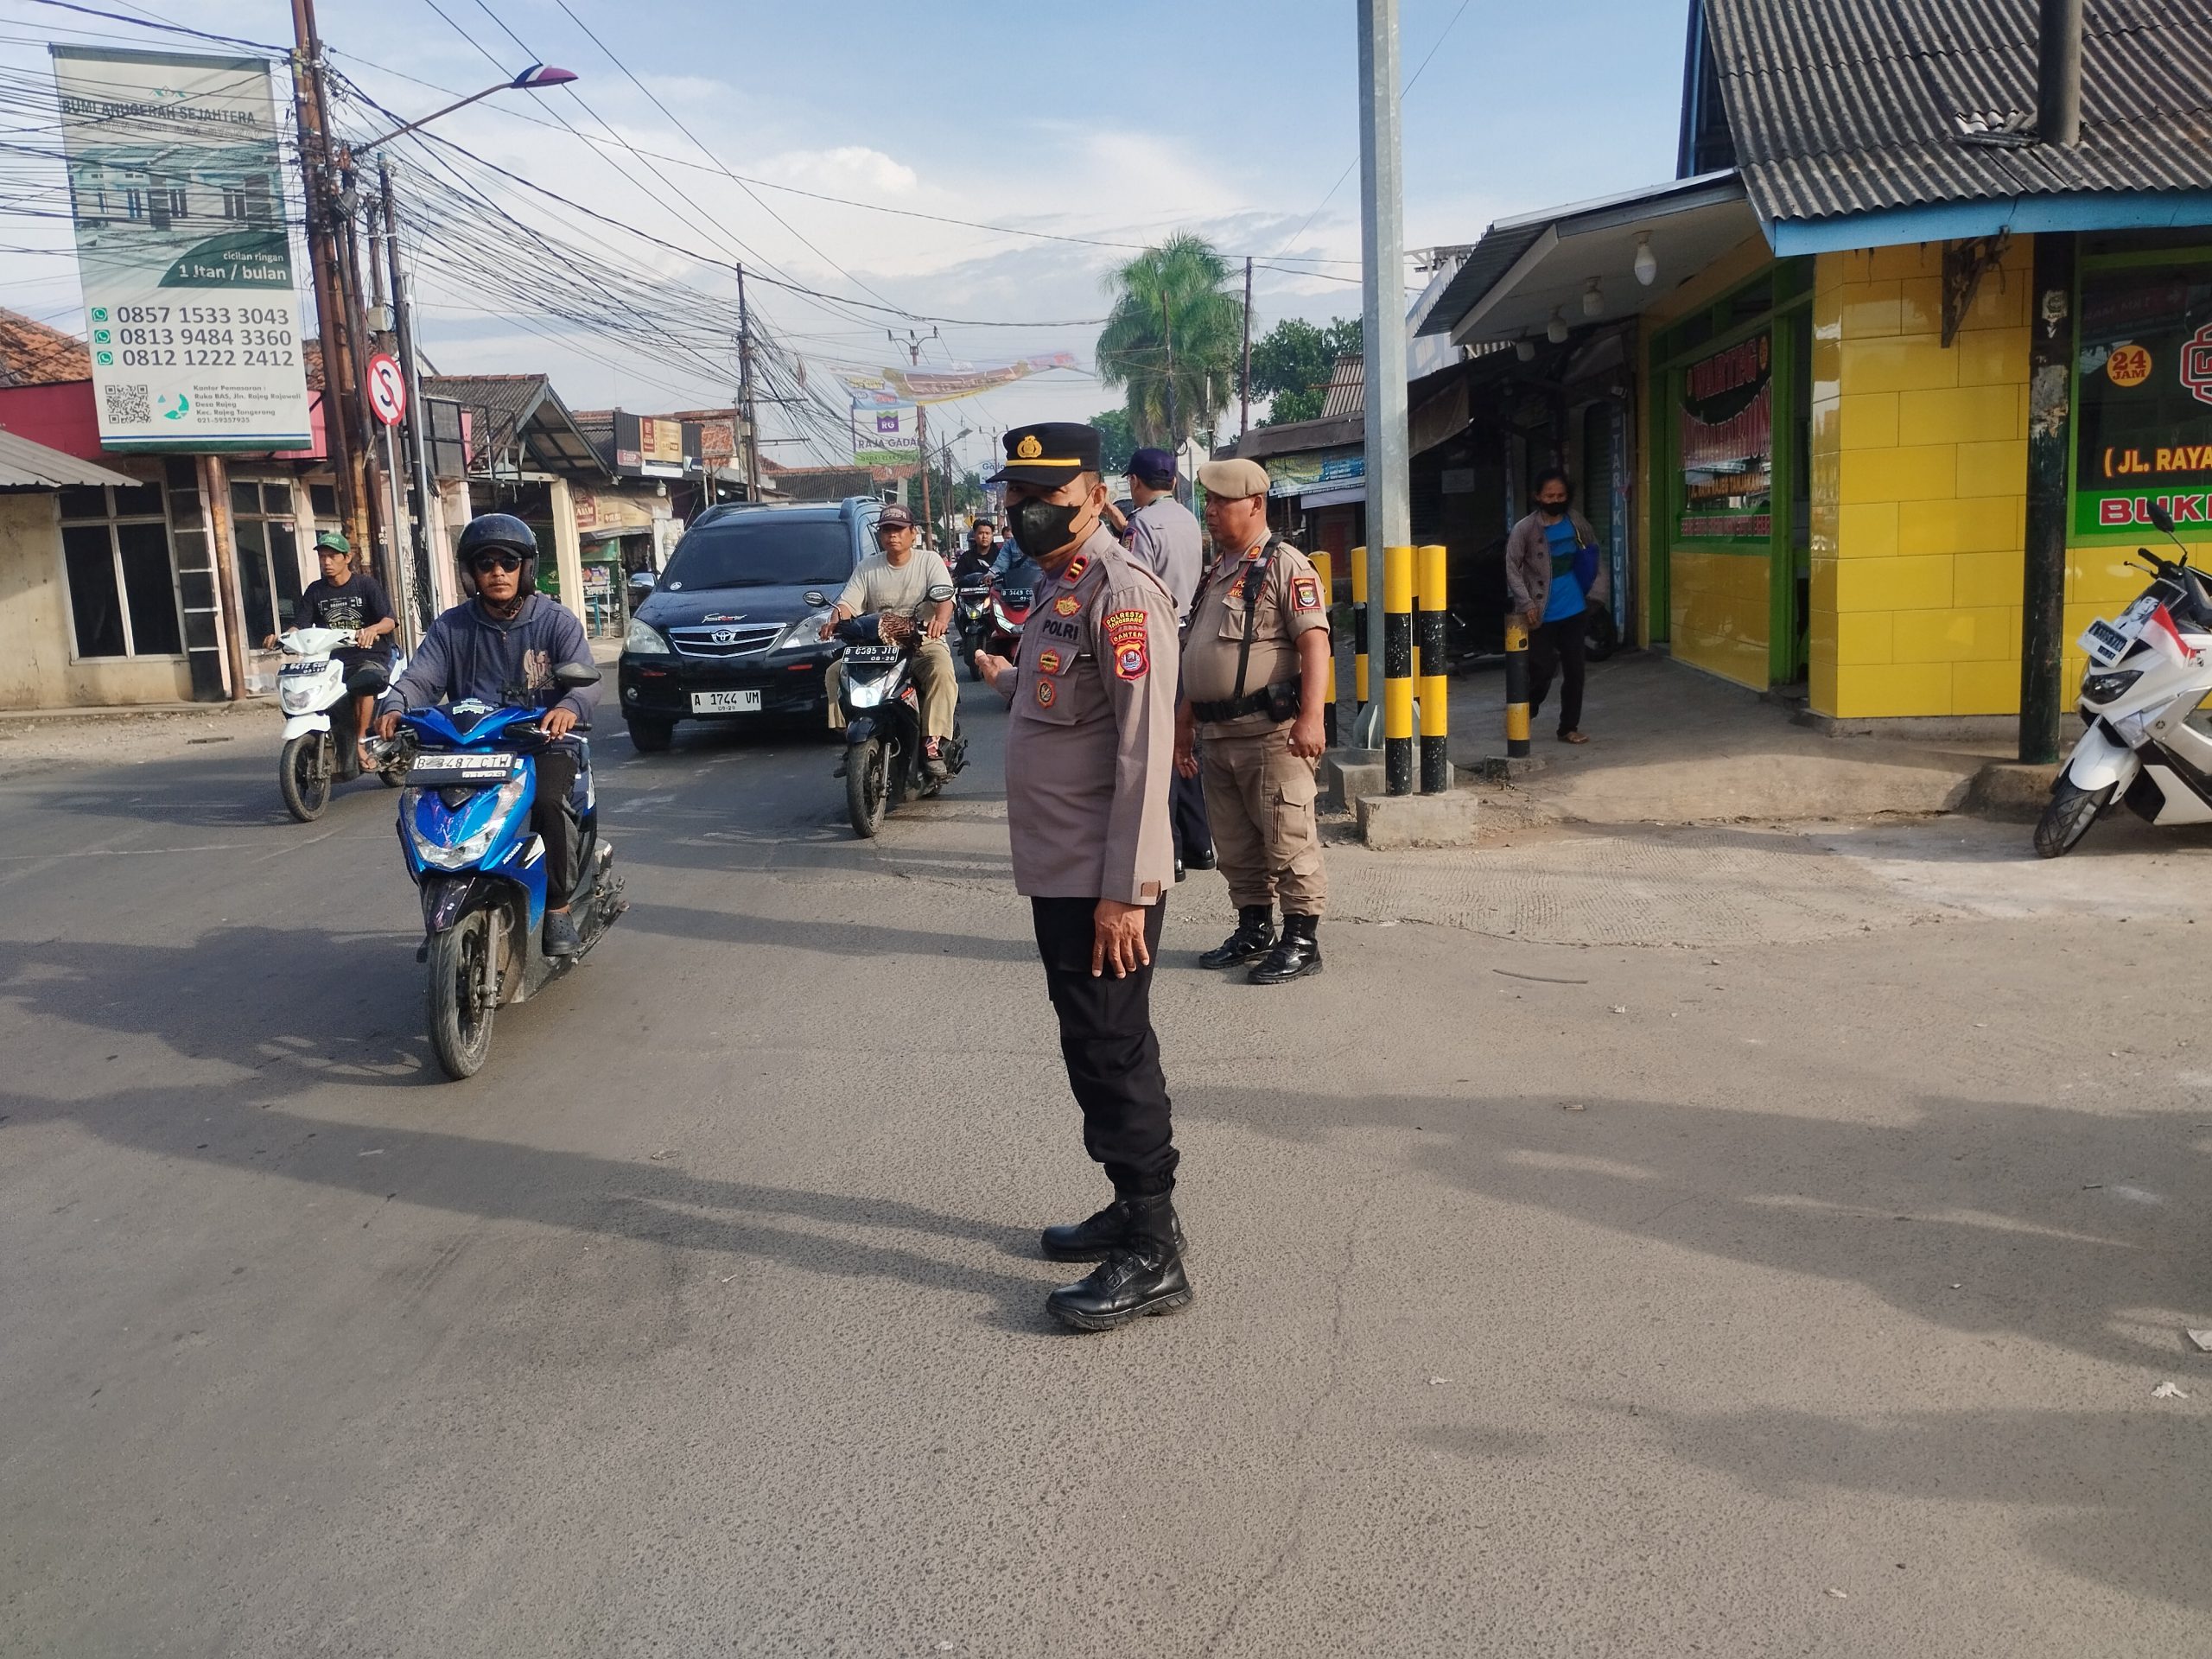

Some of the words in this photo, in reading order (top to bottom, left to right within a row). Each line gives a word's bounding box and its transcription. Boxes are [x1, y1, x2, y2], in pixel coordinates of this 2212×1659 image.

[180, 106, 257, 125] SEJAHTERA
[223, 251, 252, 260] cicilan
[255, 252, 283, 263] ringan
[179, 264, 188, 277] 1
[243, 266, 287, 281] bulan
[117, 307, 170, 323] 0857
[180, 308, 231, 323] 1533
[238, 308, 289, 325] 3043
[120, 328, 174, 345] 0813
[181, 328, 234, 346] 9484
[241, 330, 292, 346] 3360
[123, 349, 177, 366] 0812
[184, 350, 237, 366] 1222
[244, 350, 295, 366] 2412
[2112, 350, 2146, 371] 24
[2112, 368, 2145, 380] JAM
[881, 421, 895, 429] RG
[2118, 448, 2151, 474] JL.
[2157, 445, 2212, 472] RAYA
[2100, 493, 2212, 525] BUK
[1106, 611, 1144, 626] POLRESTA
[1042, 620, 1079, 640] POLRI
[1113, 632, 1143, 642] BANTEN
[695, 695, 701, 706] A
[710, 693, 738, 705] 1744
[746, 692, 760, 704] VM
[416, 758, 426, 769] B
